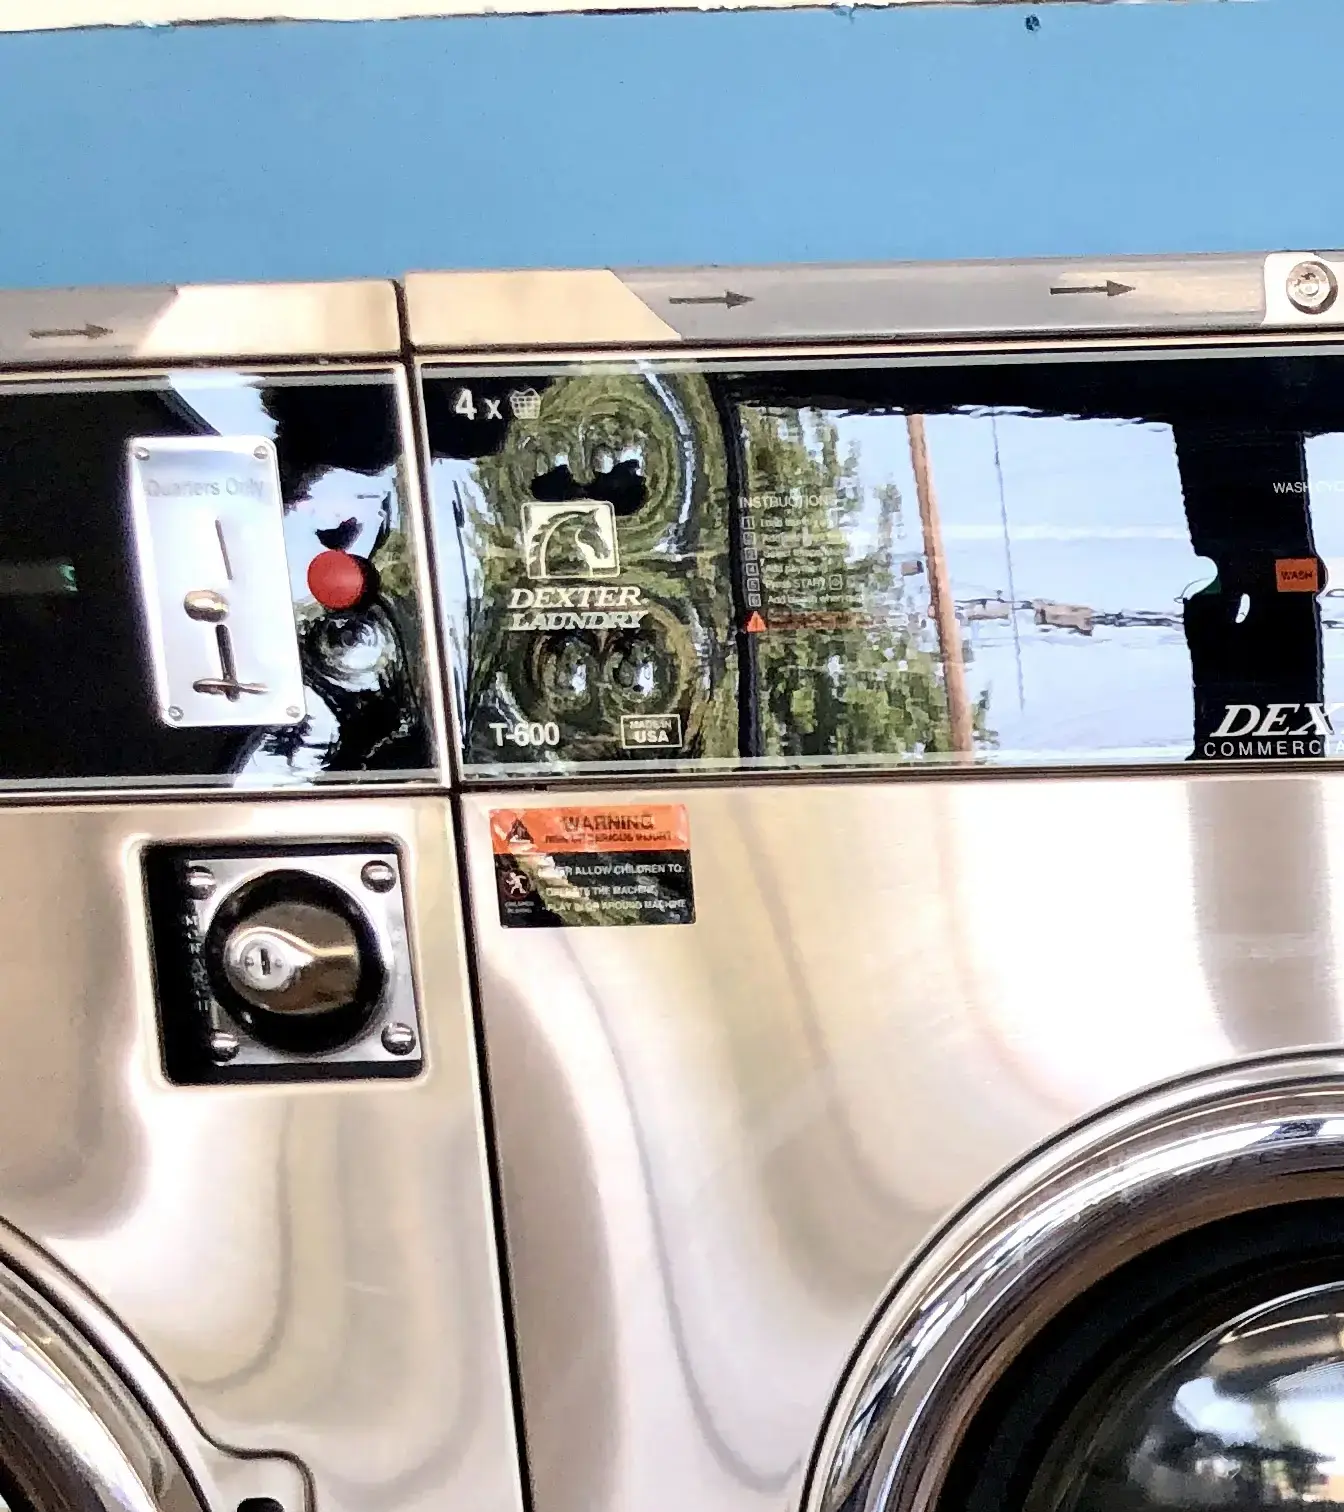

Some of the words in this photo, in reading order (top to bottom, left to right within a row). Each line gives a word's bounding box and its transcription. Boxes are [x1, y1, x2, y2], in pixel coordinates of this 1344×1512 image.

[455, 387, 477, 420] 4
[484, 398, 503, 420] x
[1273, 482, 1309, 494] WASH
[507, 586, 642, 609] DEXTER
[508, 610, 650, 631] LAUNDRY
[489, 722, 560, 747] T-600
[634, 730, 670, 743] USA
[562, 813, 655, 832] WARNING
[575, 864, 612, 875] ALLOW
[613, 863, 665, 875] CHILDREN
[591, 886, 611, 896] THE
